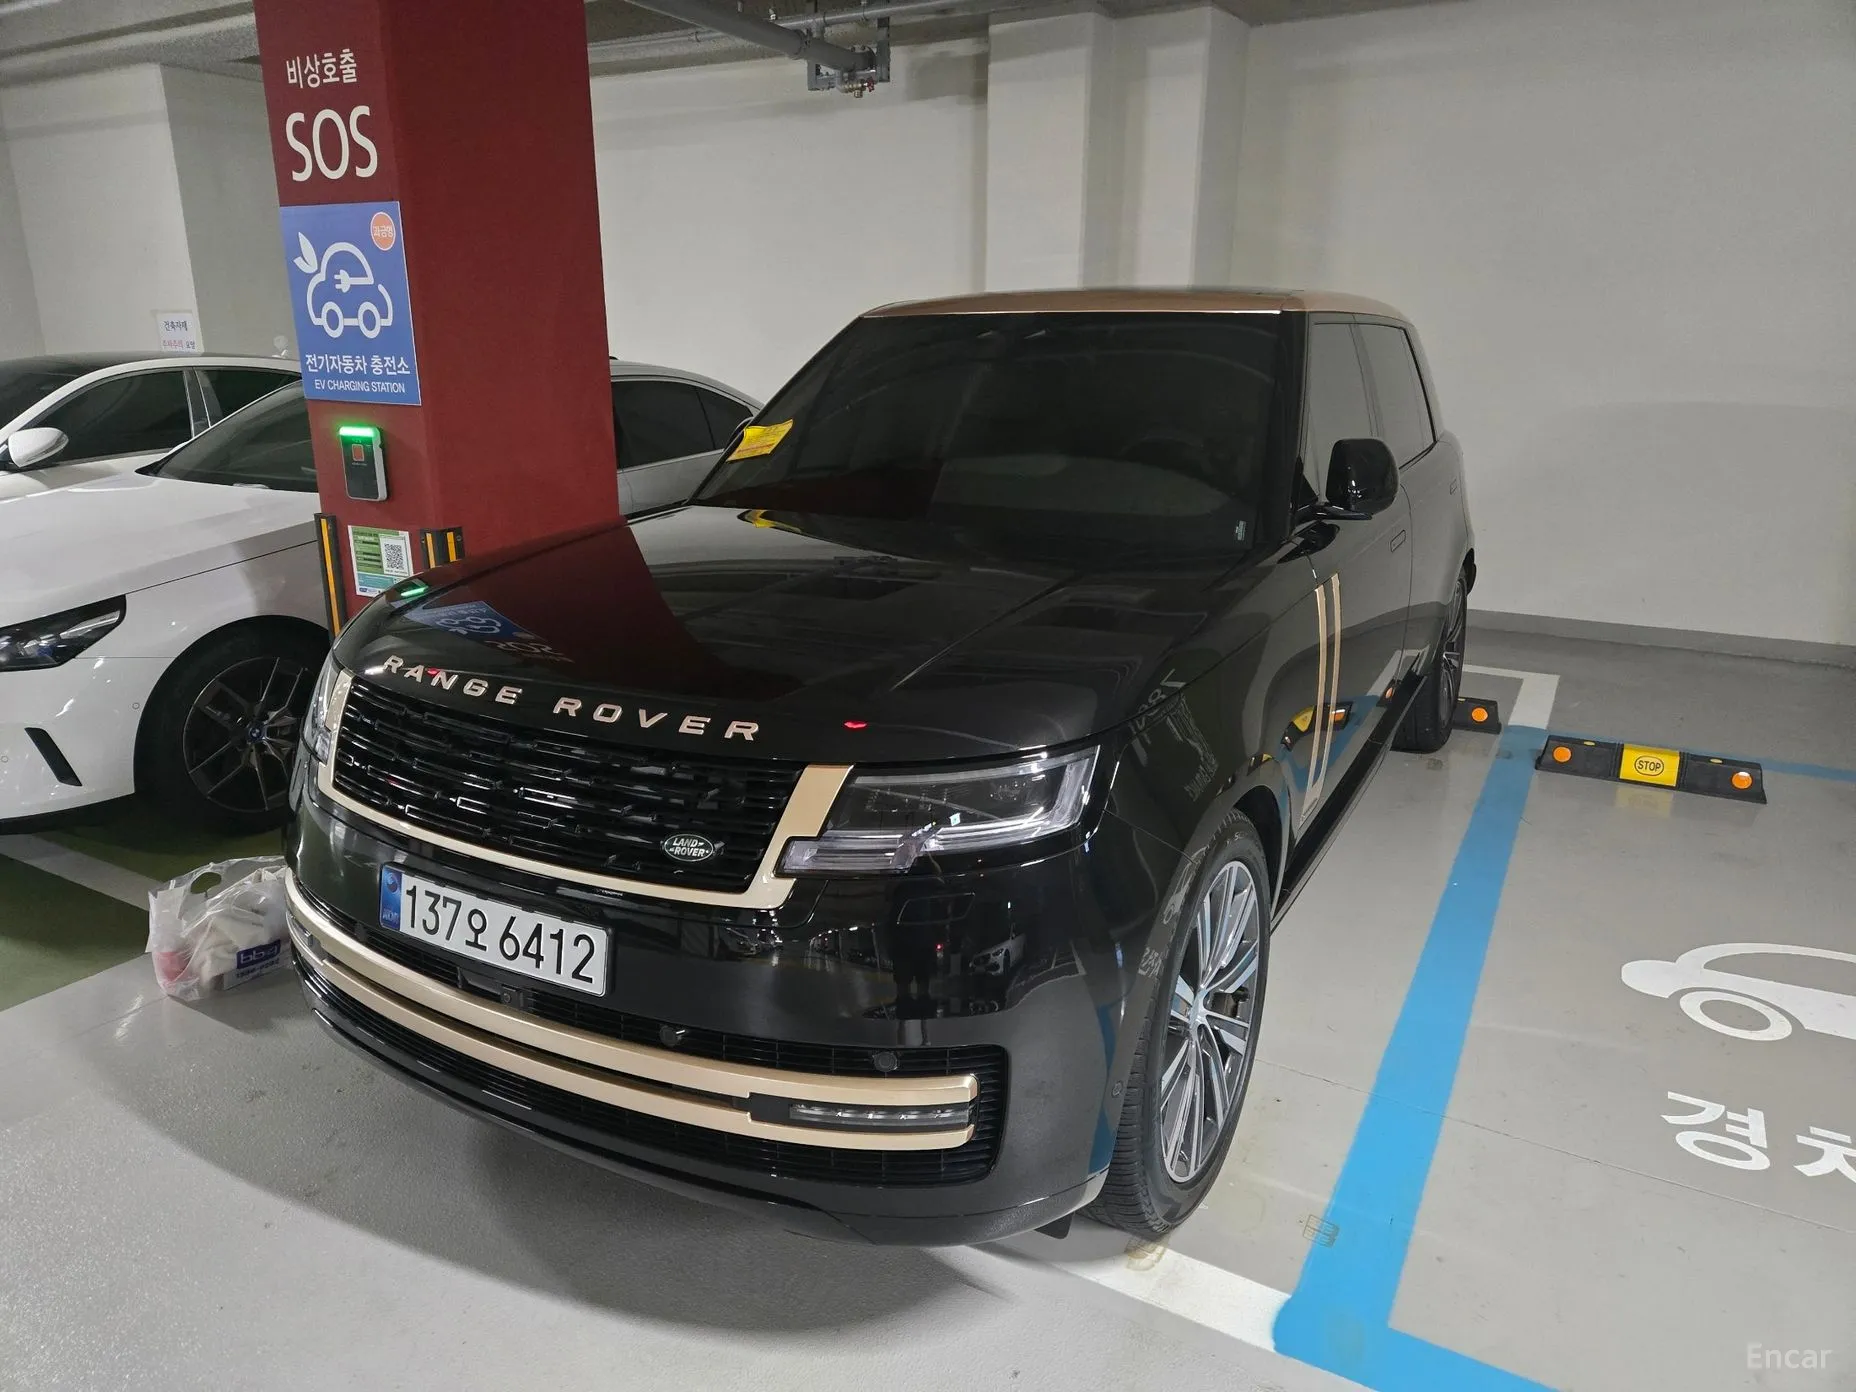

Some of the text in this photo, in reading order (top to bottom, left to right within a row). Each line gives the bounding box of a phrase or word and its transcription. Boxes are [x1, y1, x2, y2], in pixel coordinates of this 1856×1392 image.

[285, 48, 358, 89] 비상호출
[285, 105, 378, 182] SOS
[305, 353, 411, 376] 전기자동차 충전소
[314, 379, 405, 393] EV CHARGING STATION
[382, 655, 760, 741] RANGE ROVER
[1637, 759, 1662, 772] STOP
[672, 837, 699, 848] LAND
[673, 846, 706, 857] ROVER
[405, 885, 596, 984] 137오 6412
